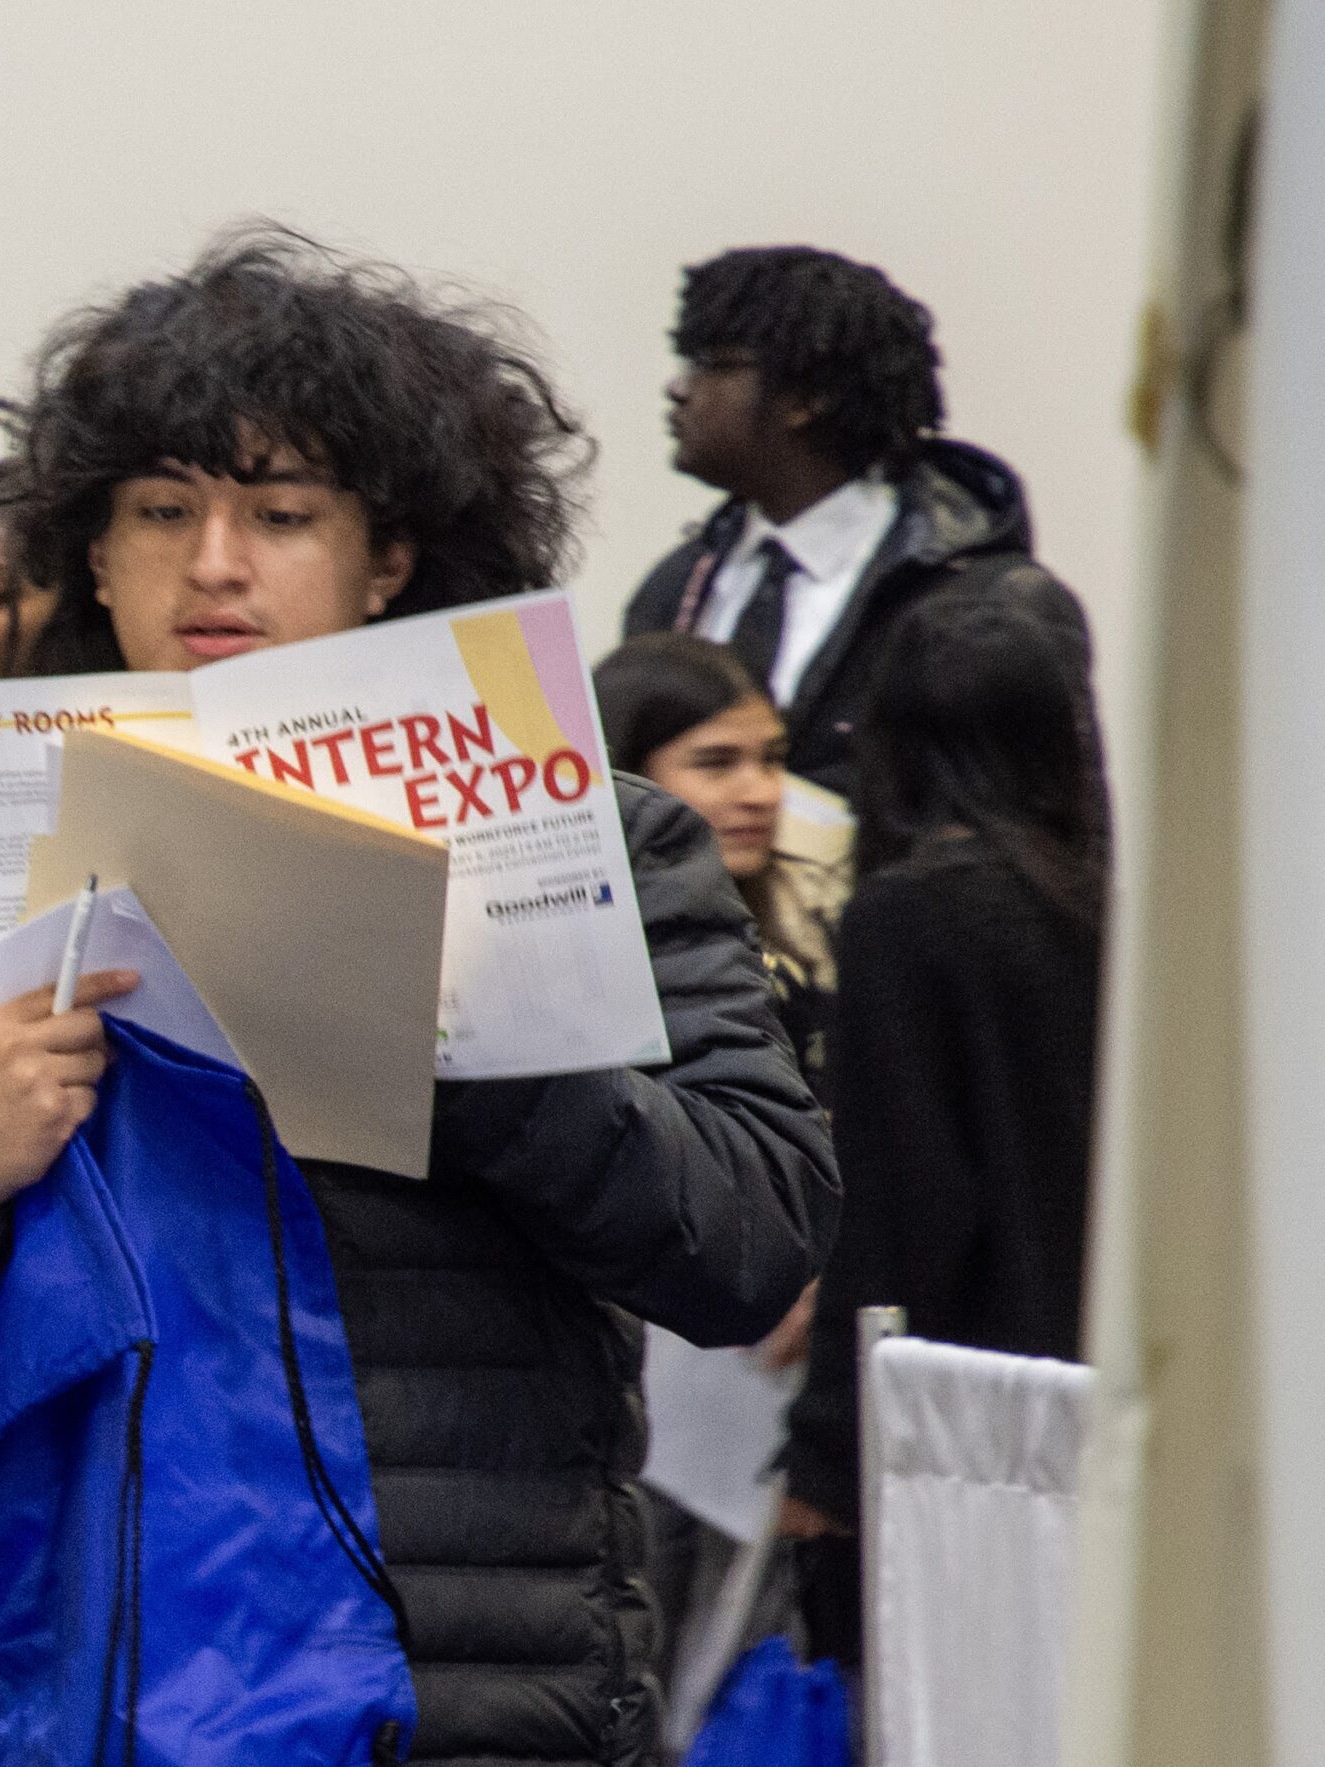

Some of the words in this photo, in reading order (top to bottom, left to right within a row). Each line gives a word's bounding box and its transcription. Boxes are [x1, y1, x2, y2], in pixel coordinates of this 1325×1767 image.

[13, 706, 116, 735] ROOMS
[228, 725, 270, 748] 4TH
[277, 706, 367, 738] ANNUAL
[404, 747, 592, 830] EXPO
[541, 809, 595, 834] FUTURE
[485, 885, 587, 919] Goodwill
